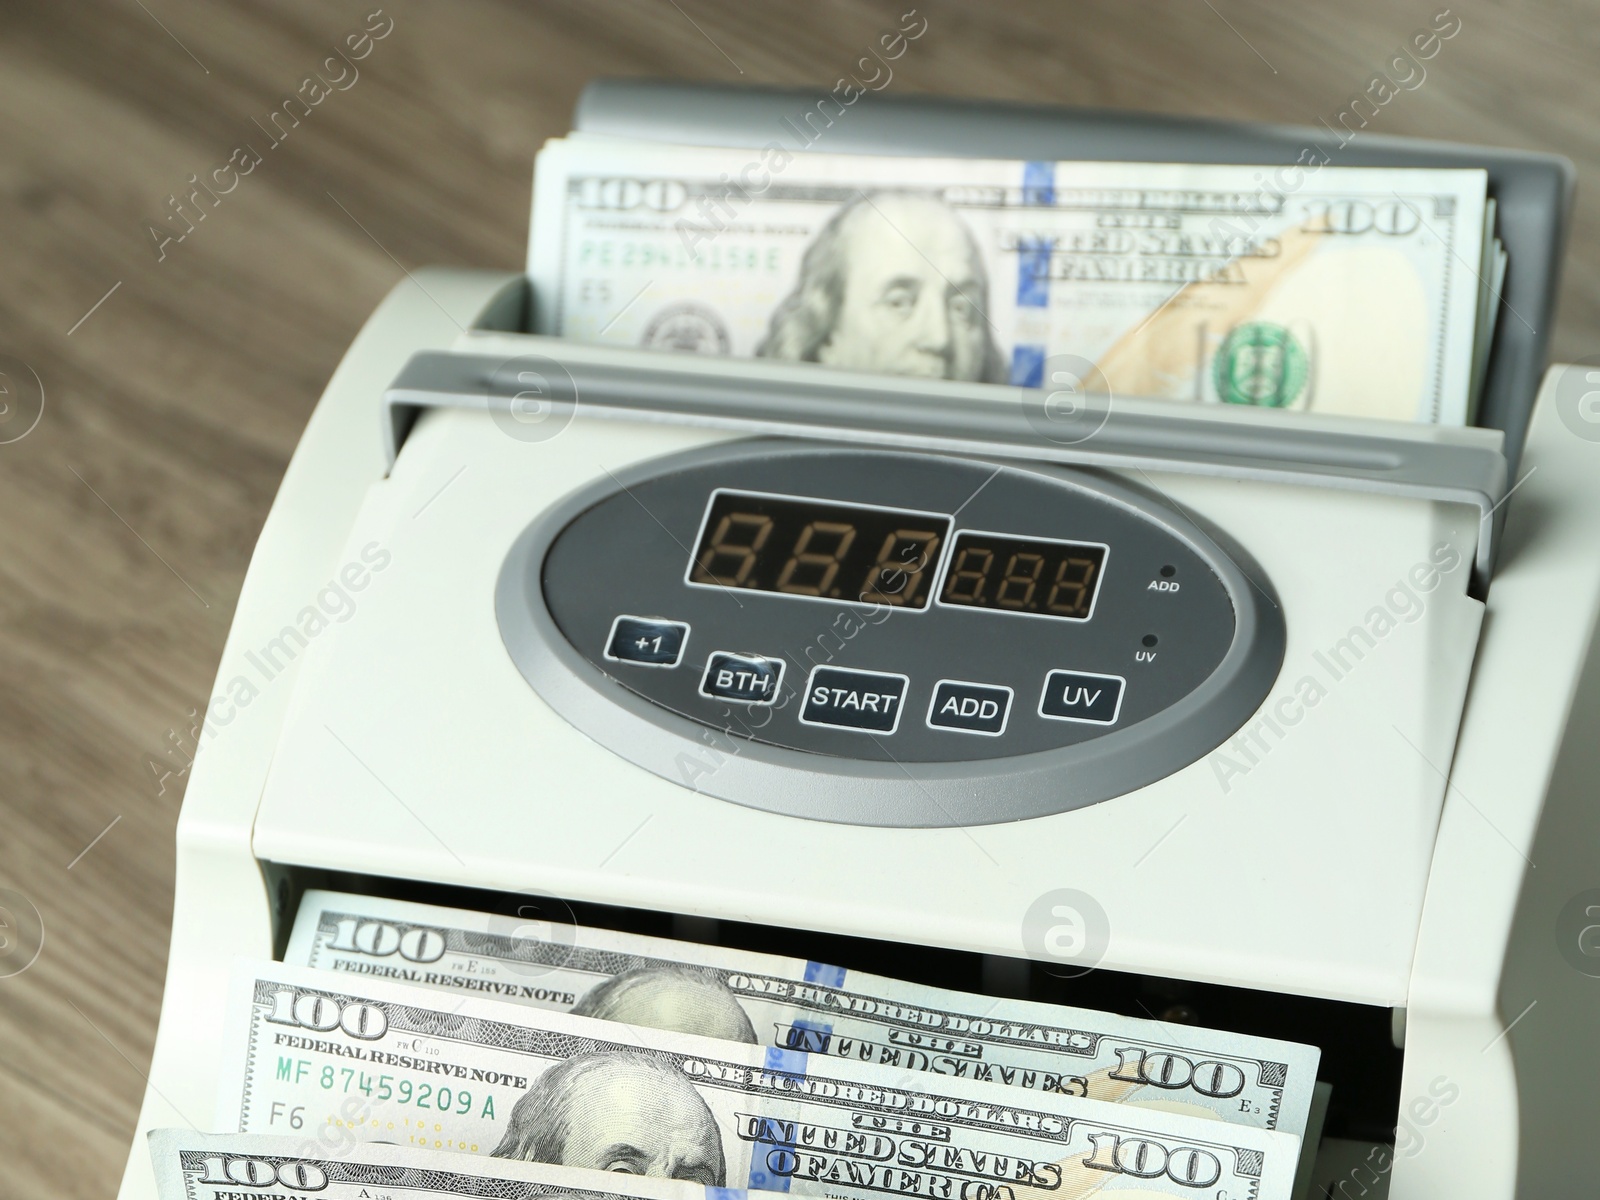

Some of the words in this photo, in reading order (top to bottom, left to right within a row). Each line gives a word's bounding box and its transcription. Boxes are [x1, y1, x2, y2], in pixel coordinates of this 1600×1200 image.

[579, 177, 686, 213] 100
[1301, 199, 1421, 236] 100
[1148, 580, 1180, 593] ADD
[635, 635, 663, 653] +1
[1136, 651, 1157, 663] UV
[716, 670, 770, 692] BTH
[1063, 686, 1101, 707] UV
[812, 686, 897, 713] START
[941, 696, 998, 719] ADD
[327, 919, 446, 963] 100
[333, 959, 422, 982] FEDERAL
[425, 970, 517, 997] RESERVE
[520, 985, 575, 1006] NOTE
[264, 990, 388, 1040] 100
[728, 973, 788, 998] ONE
[791, 984, 943, 1030] HUNDRED
[946, 1018, 1092, 1051] DOLLARS
[412, 1038, 423, 1052] C
[773, 1022, 928, 1073] UNITED
[888, 1028, 983, 1058] THE
[274, 1033, 367, 1060] FEDERAL
[370, 1048, 467, 1078] RESERVE
[471, 1069, 528, 1089] NOTE
[1108, 1047, 1246, 1098] 100
[276, 1056, 311, 1084] MF
[320, 1065, 472, 1115] 87459209
[481, 1095, 495, 1120] A
[683, 1059, 745, 1082] ONE
[748, 1071, 908, 1109] HUNDRED
[911, 1098, 1065, 1137] DOLLARS
[269, 1102, 305, 1129] F6
[1238, 1099, 1252, 1113] E
[1254, 1107, 1261, 1115] 3
[852, 1112, 951, 1142] THE
[734, 1112, 895, 1162] UNITED
[897, 1139, 1062, 1190] STATES
[766, 1149, 827, 1182] OF
[1082, 1131, 1221, 1188] 100
[198, 1156, 328, 1191] 100
[358, 1188, 370, 1199] A
